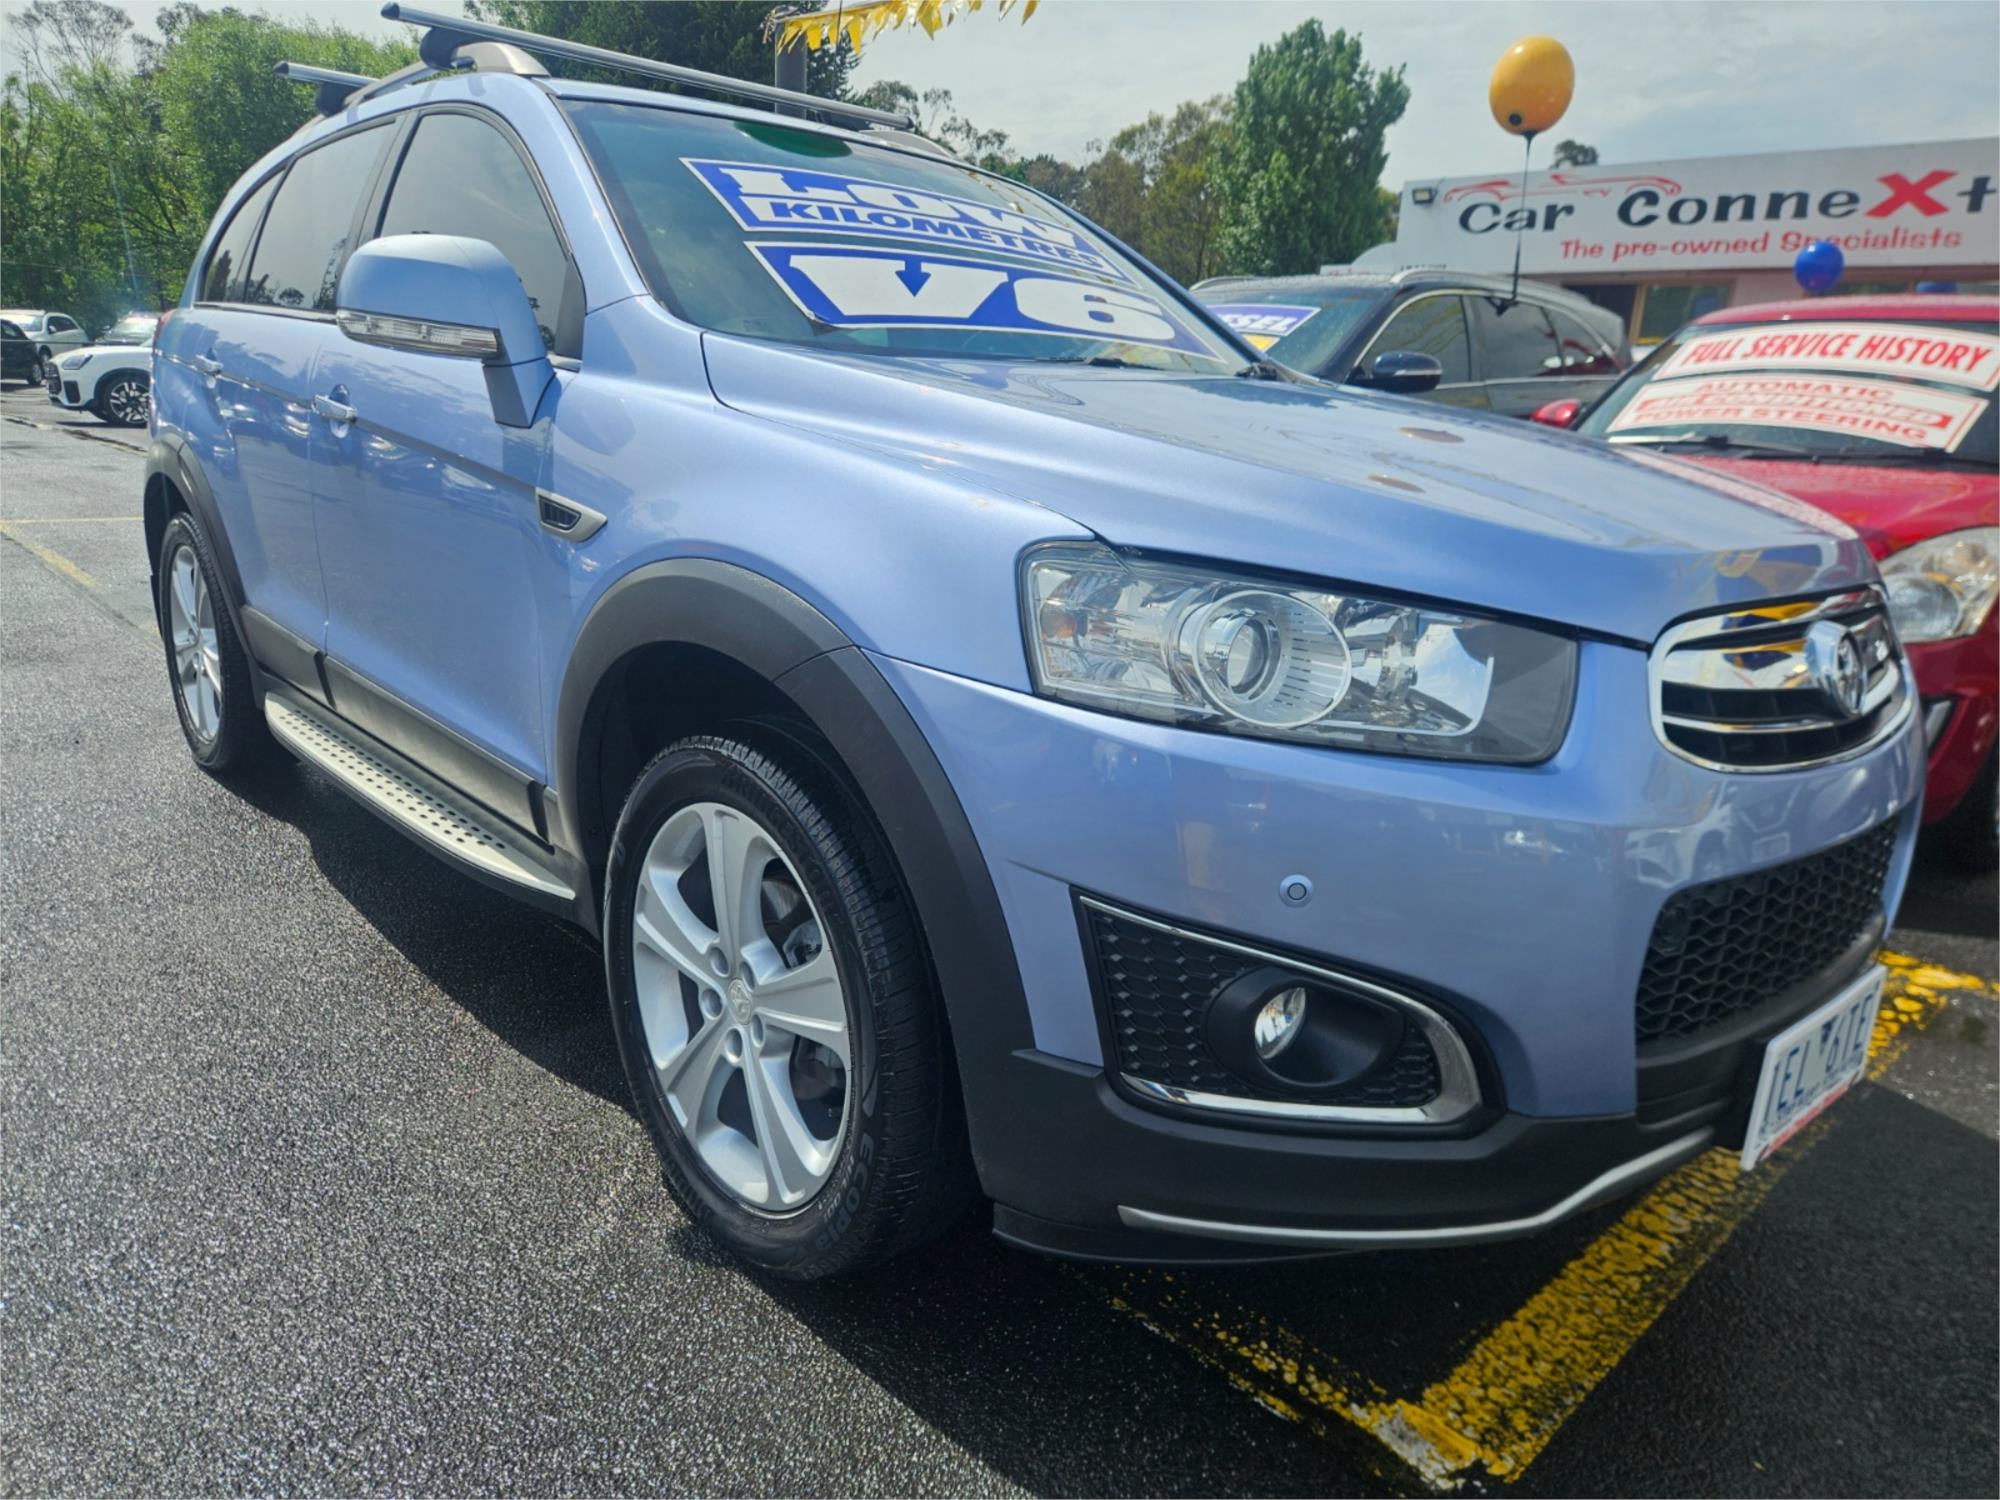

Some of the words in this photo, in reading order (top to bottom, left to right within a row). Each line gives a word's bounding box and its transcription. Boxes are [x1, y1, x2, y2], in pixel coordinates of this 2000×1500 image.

[718, 167, 1078, 249] LOW
[1458, 202, 1576, 236] Car
[1616, 170, 1998, 228] ConneXt
[770, 201, 1105, 269] KILOMETRES
[1561, 238, 1604, 260] The
[1611, 231, 1770, 264] pre-owned
[788, 255, 1176, 340] V6
[1680, 338, 1744, 367] FULL
[1742, 333, 1858, 361] SERVICE
[1856, 336, 1992, 374] HISTORY
[1695, 382, 1894, 400] AUTOMATIC
[1633, 407, 1743, 423] POWER
[1750, 408, 1928, 441] STEERING
